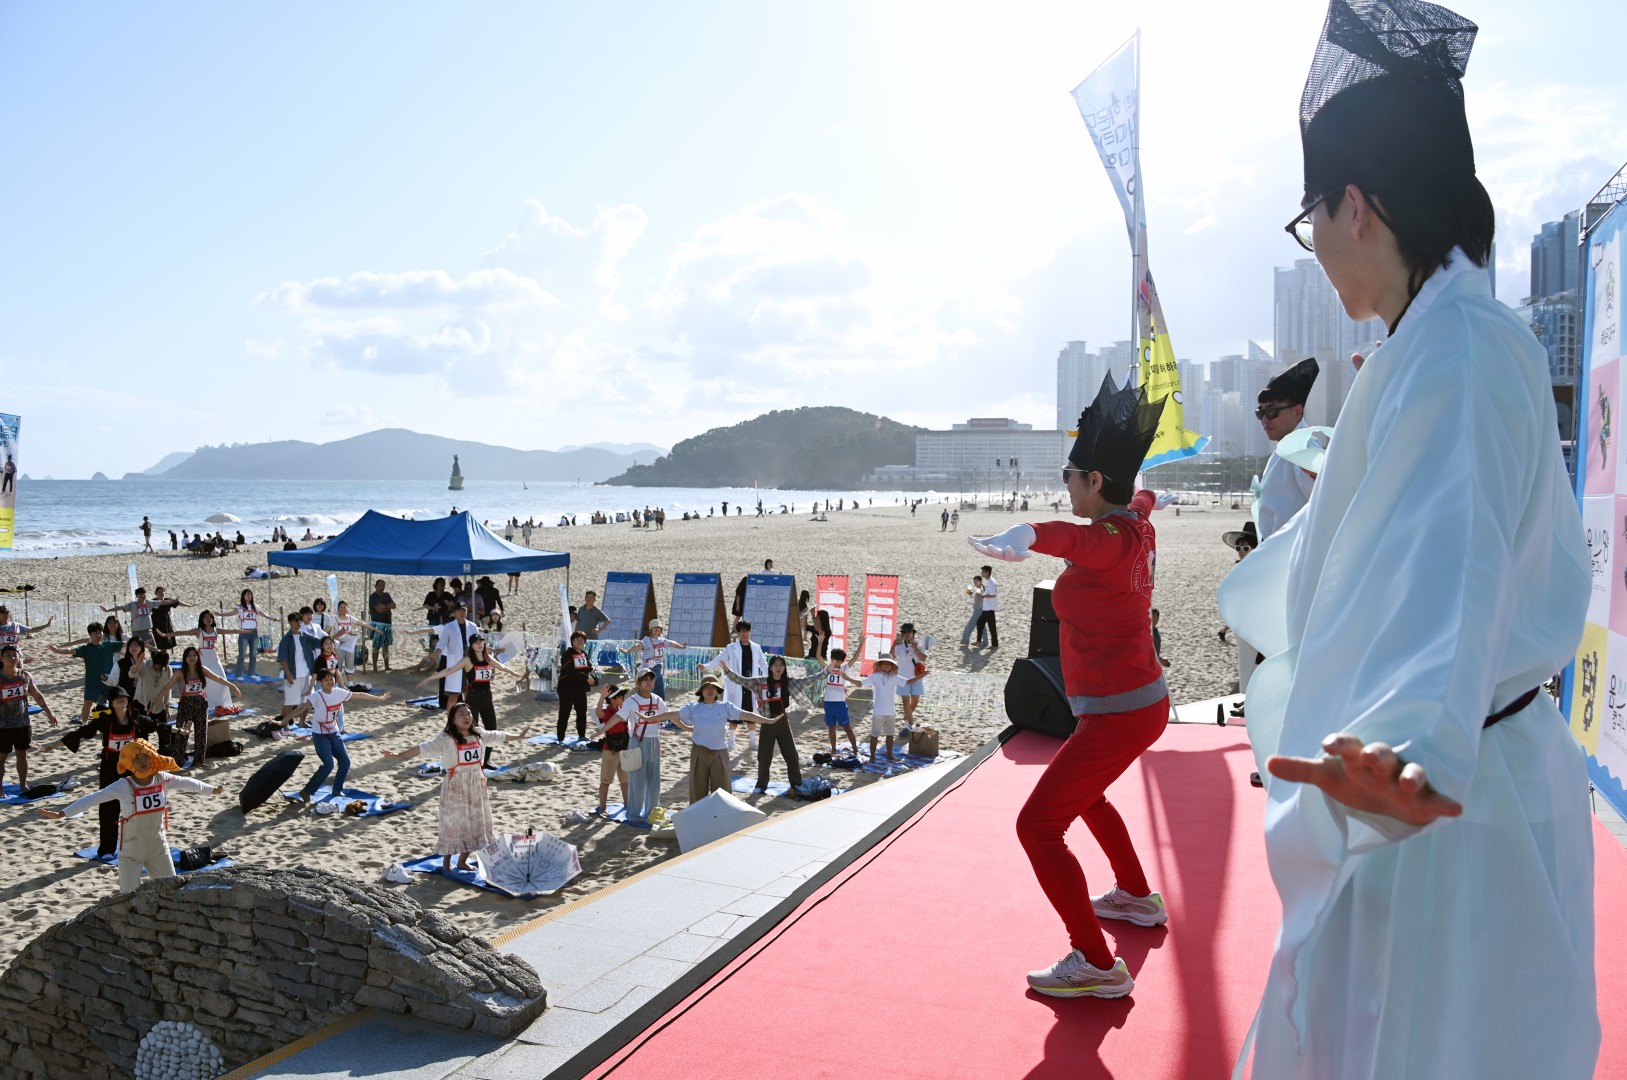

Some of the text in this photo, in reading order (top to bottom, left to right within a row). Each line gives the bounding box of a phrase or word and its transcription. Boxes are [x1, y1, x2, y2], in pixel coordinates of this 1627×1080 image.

[578, 658, 586, 666] 12
[480, 670, 490, 679] 13
[829, 674, 840, 684] 01
[7, 688, 21, 698] 24
[464, 749, 479, 762] 04
[142, 793, 161, 809] 05
